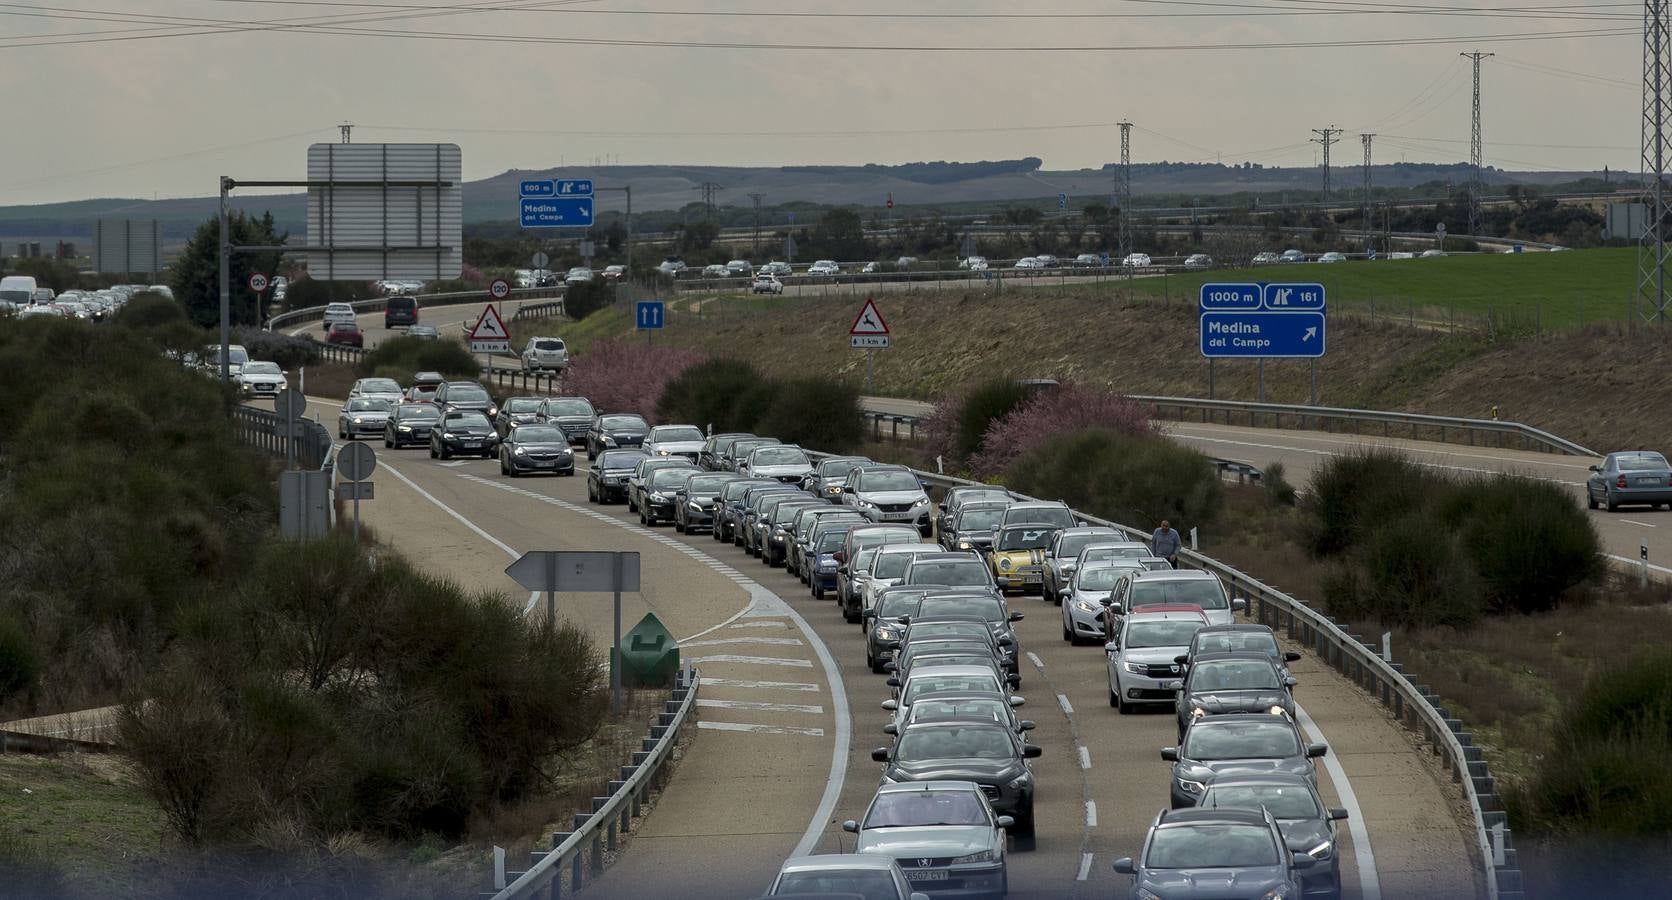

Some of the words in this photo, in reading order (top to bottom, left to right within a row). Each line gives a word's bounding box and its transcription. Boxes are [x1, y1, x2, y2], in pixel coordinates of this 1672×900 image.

[524, 204, 557, 213] Medina
[539, 214, 564, 222] Campo
[252, 278, 266, 286] 120
[493, 285, 507, 293] 120
[1209, 292, 1239, 302] 1000
[1243, 294, 1254, 302] m
[1300, 292, 1318, 302] 161
[1208, 322, 1261, 334] Medina
[1209, 338, 1226, 347] del
[1232, 337, 1271, 349] Campo
